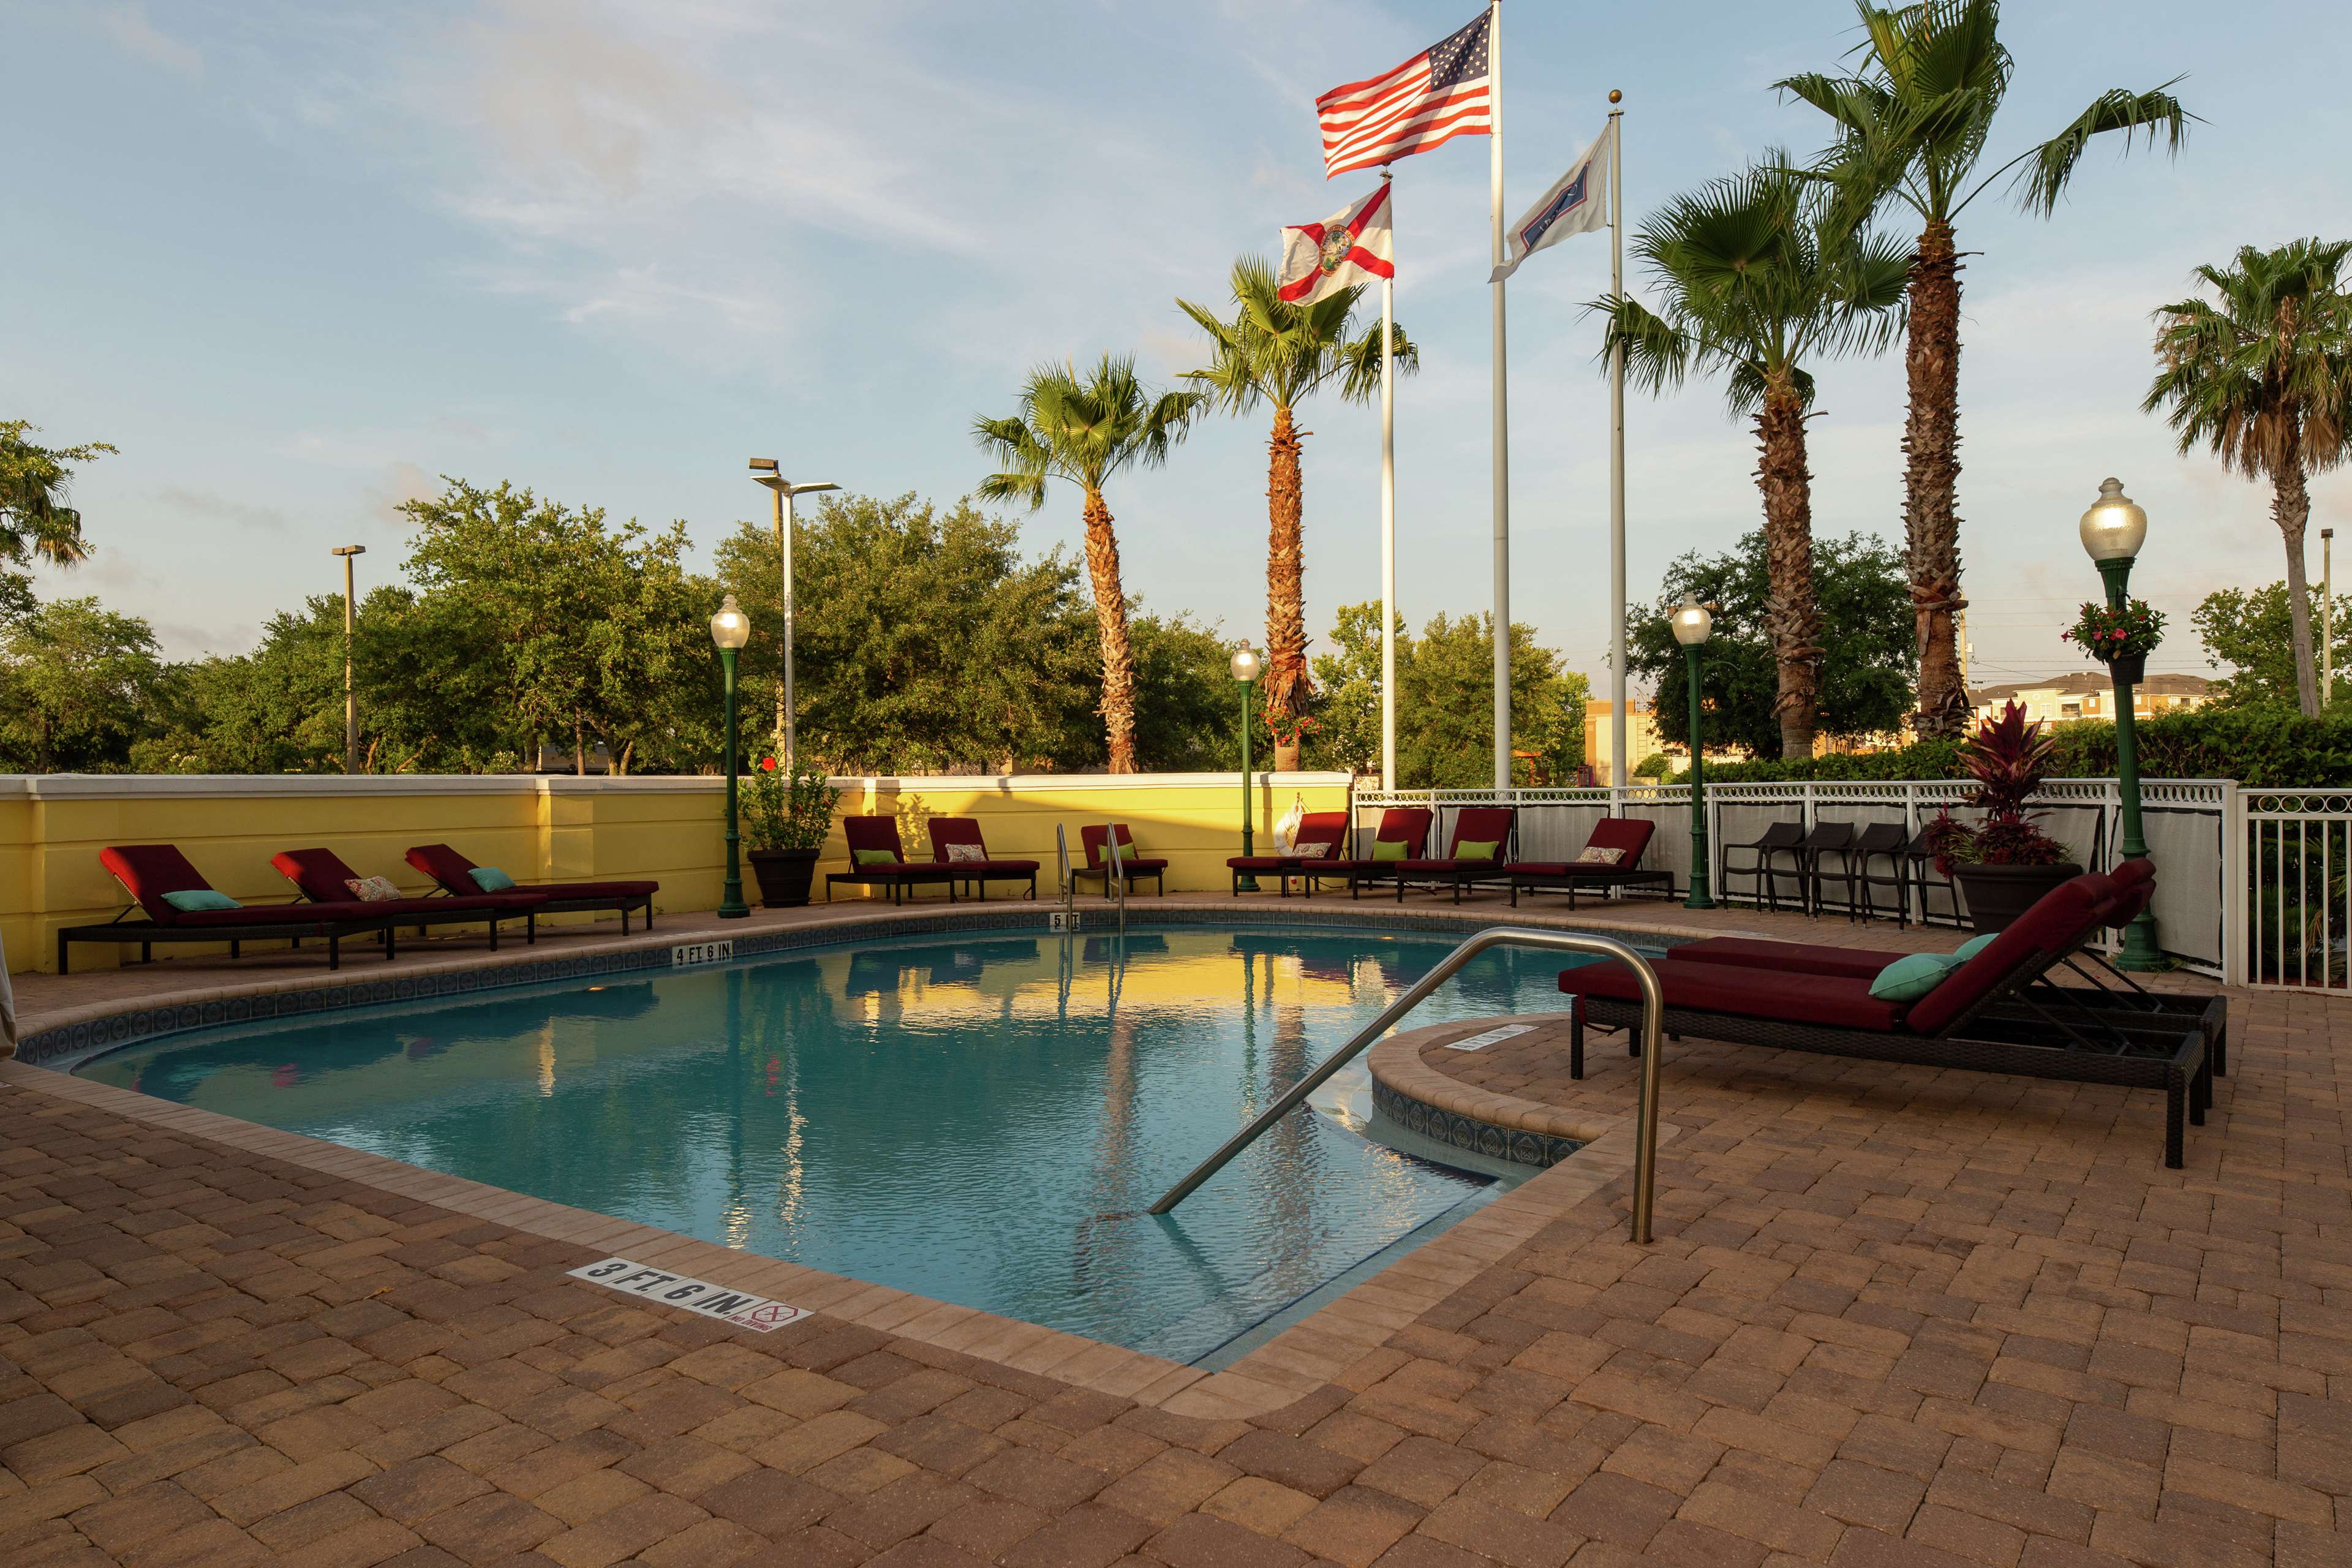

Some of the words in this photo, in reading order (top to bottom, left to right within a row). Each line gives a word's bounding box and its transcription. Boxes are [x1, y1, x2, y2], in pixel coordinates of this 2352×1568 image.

[1054, 914, 1060, 925] 5
[677, 949, 684, 962] 4
[689, 946, 702, 960] FT.
[707, 945, 714, 957] 6
[587, 1263, 628, 1277] 3
[612, 1270, 678, 1291] FT.
[664, 1284, 706, 1300] 6
[691, 1292, 754, 1314] IN.
[741, 1319, 773, 1331] DIVING
